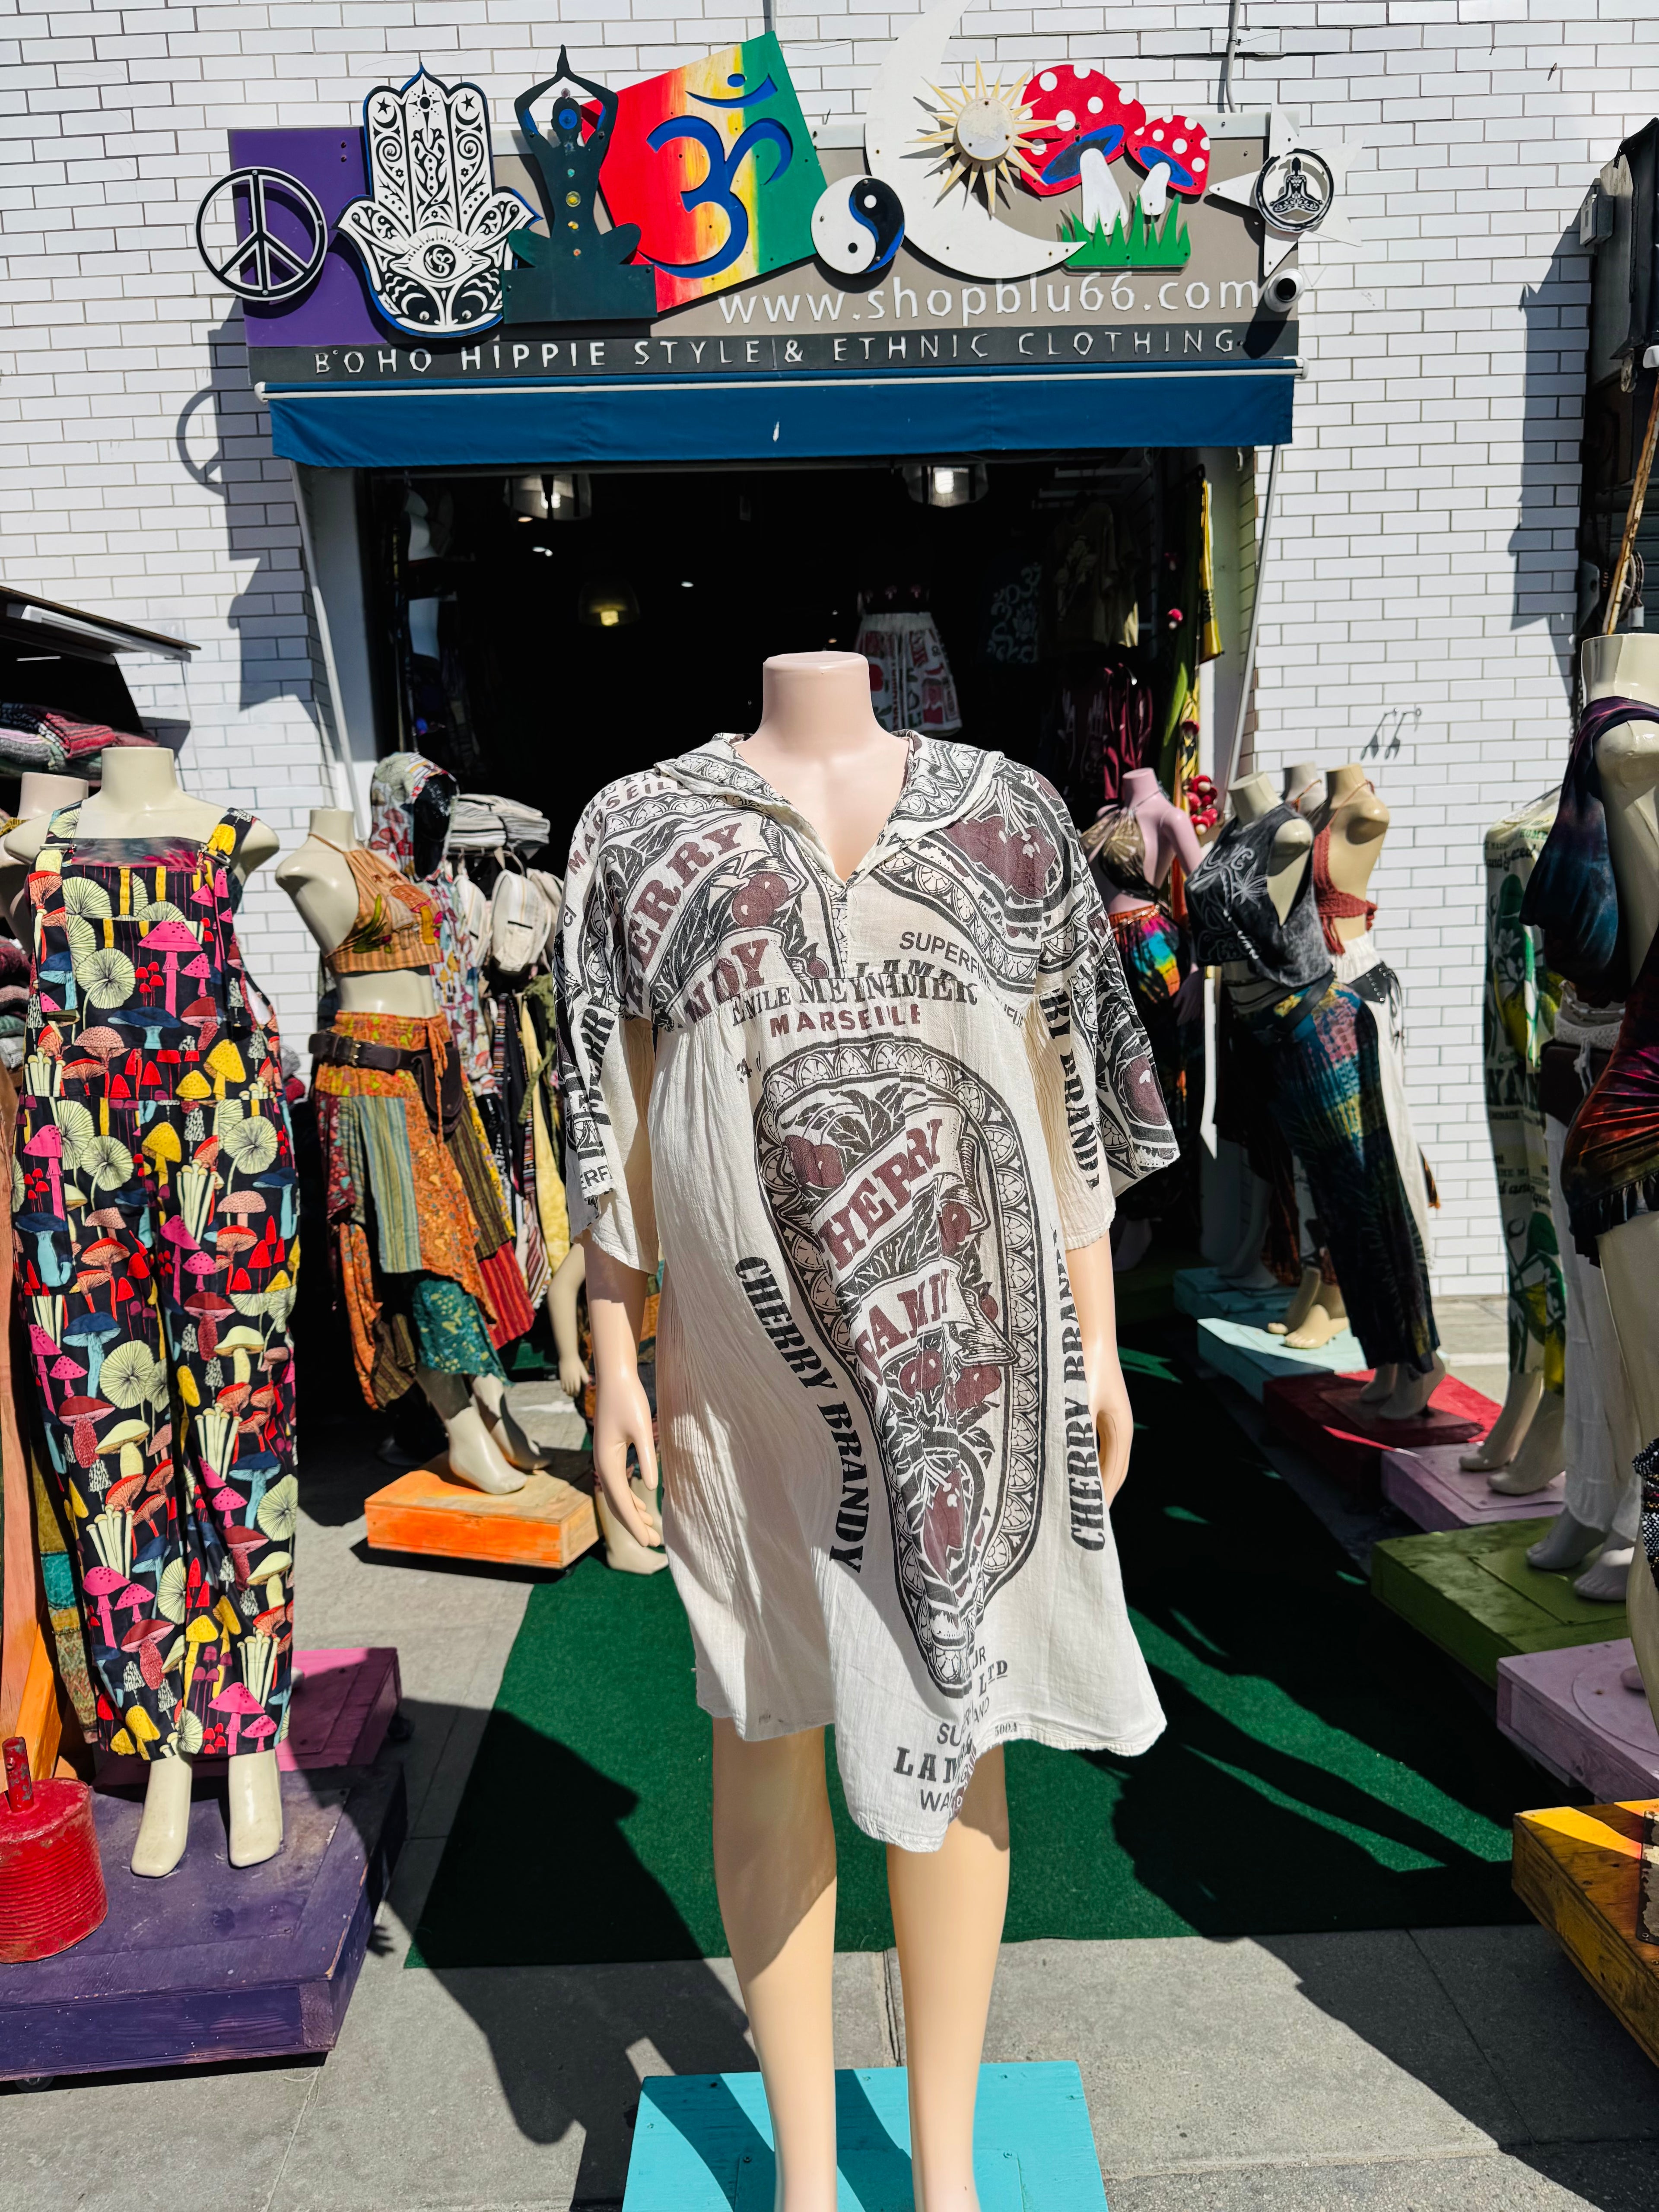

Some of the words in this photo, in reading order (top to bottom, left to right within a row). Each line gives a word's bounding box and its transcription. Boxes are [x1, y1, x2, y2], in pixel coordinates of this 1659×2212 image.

[315, 346, 432, 374] BOHO
[461, 341, 605, 371] HIPPIE
[634, 340, 761, 365] STYLE
[783, 340, 804, 363] &
[833, 333, 989, 362] ETHNIC
[1018, 328, 1234, 357] CLOTHING
[717, 271, 1259, 327] www.shopblu66.com
[735, 1256, 838, 1389] CHERRY
[818, 1401, 870, 1573] BRANDY
[1065, 1396, 1106, 1551] CHERRY
